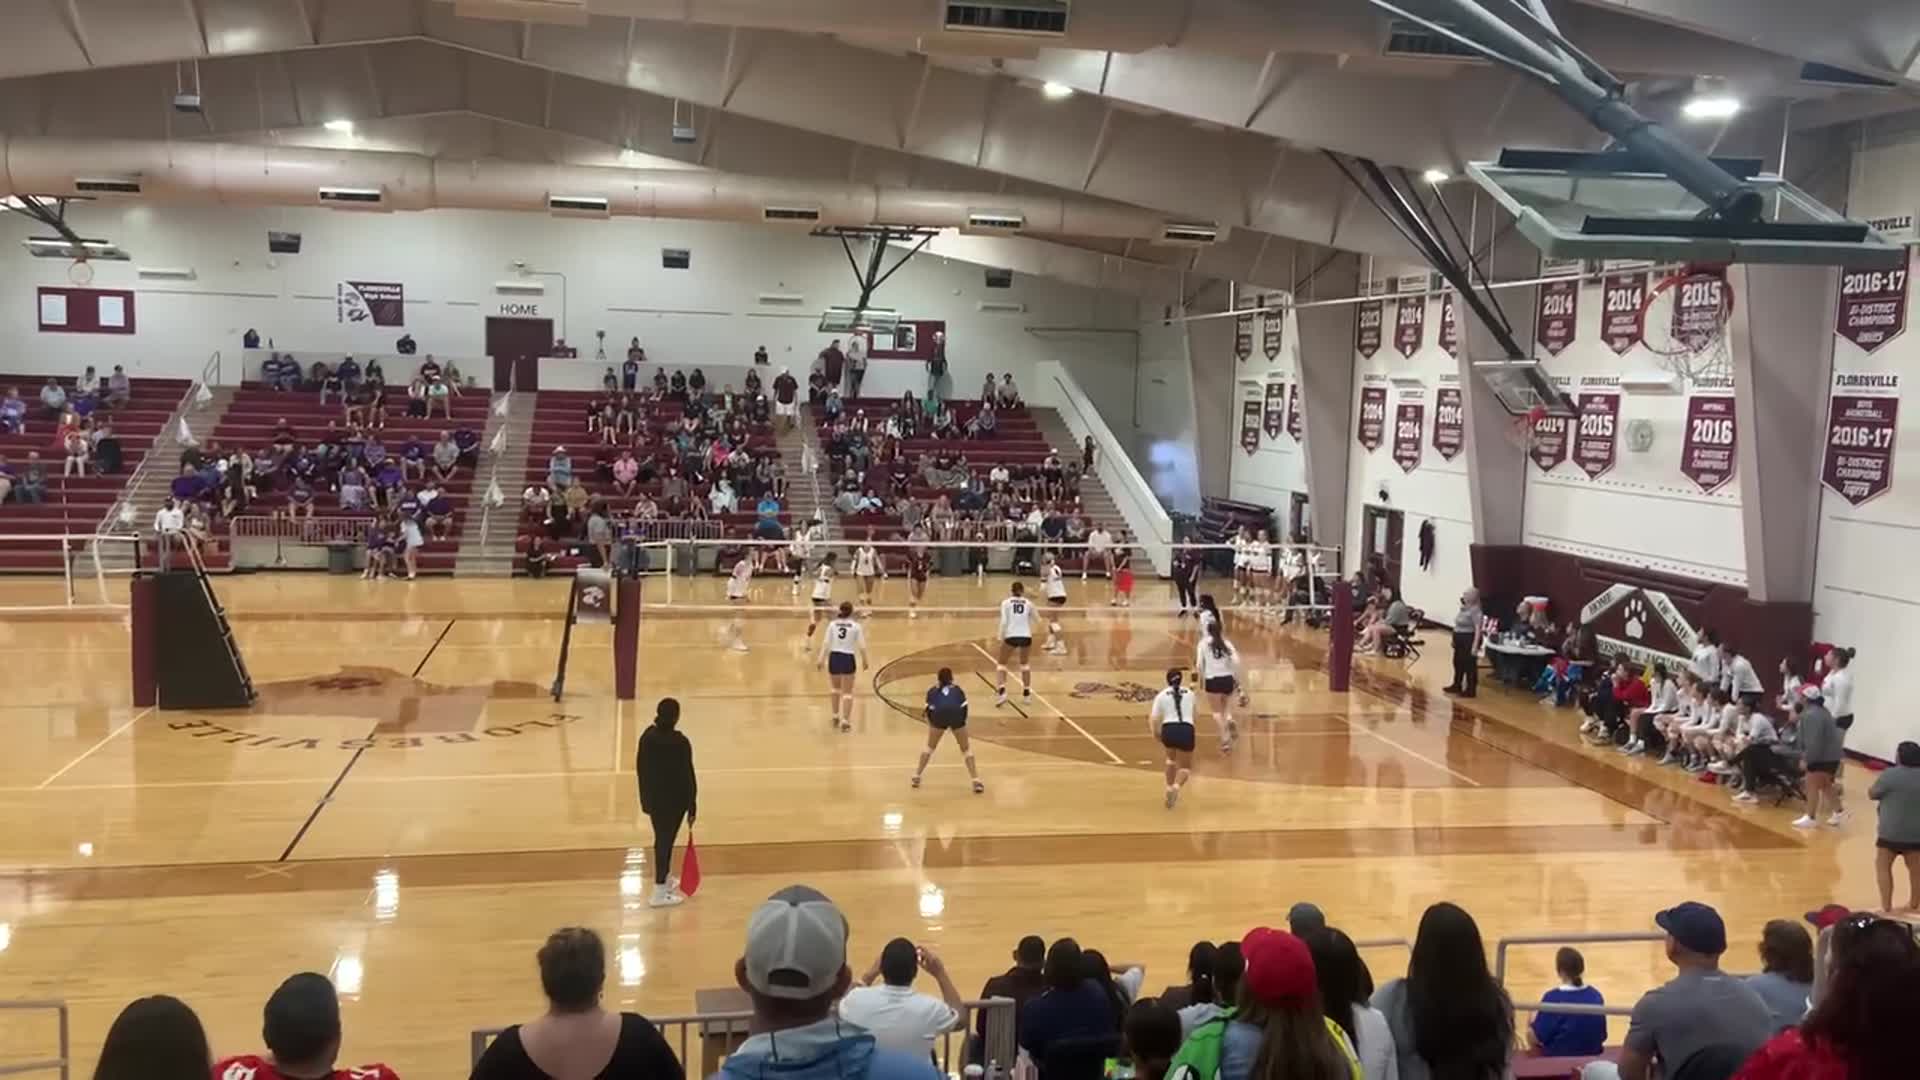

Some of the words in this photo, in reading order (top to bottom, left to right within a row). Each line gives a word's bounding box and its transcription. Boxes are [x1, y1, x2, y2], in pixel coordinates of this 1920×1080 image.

[1842, 270, 1906, 295] 2016-17
[1543, 293, 1573, 316] 2014
[1607, 287, 1641, 312] 2014
[1681, 281, 1722, 308] 2015
[500, 303, 538, 316] HOME
[1400, 306, 1422, 325] 2014
[1836, 374, 1898, 388] FLORESVILLE
[1439, 404, 1463, 425] 2014
[1580, 413, 1615, 437] 2015
[1398, 420, 1421, 440] 2014
[1692, 418, 1733, 445] 2016
[1831, 425, 1894, 449] 2016-17
[1836, 455, 1884, 469] BI-DISTRICT
[1012, 603, 1025, 615] 10
[1588, 592, 1612, 615] HOME
[837, 627, 848, 640] 3
[1670, 616, 1691, 644] THE
[168, 711, 583, 751] FLORESVILLE
